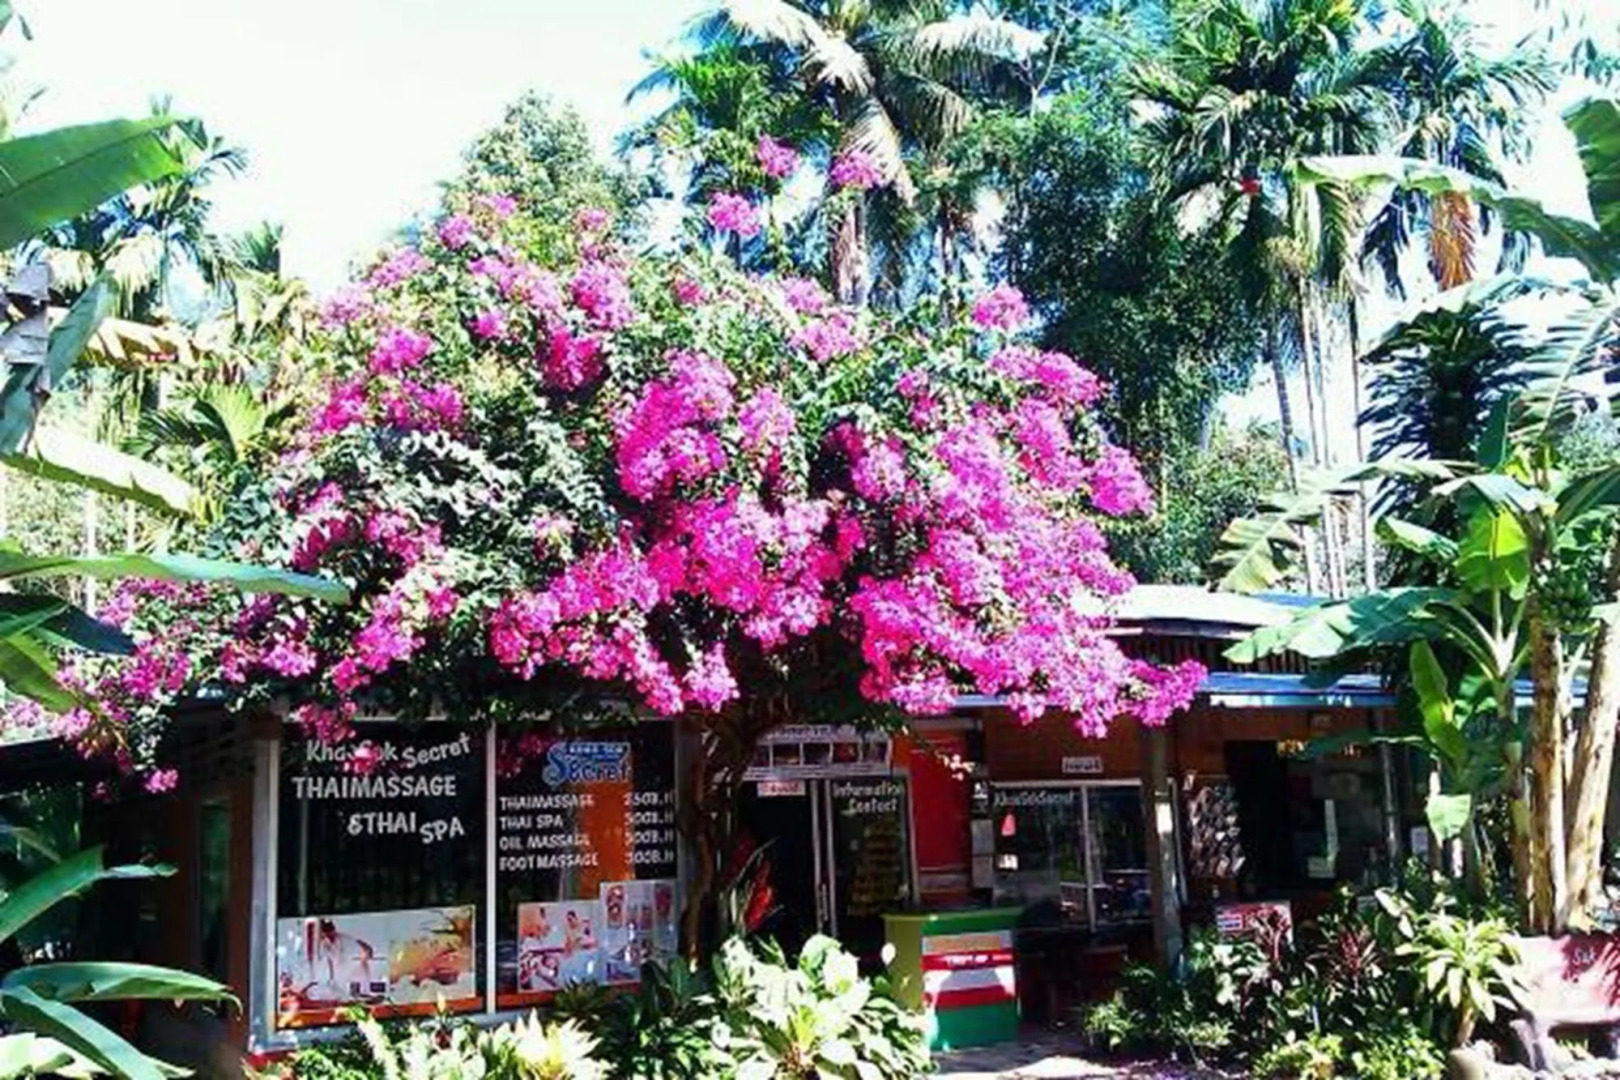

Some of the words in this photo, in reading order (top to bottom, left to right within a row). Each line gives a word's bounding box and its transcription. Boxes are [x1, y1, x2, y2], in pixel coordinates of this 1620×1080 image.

[402, 732, 470, 769] Secret
[292, 775, 457, 798] THAIMASSAGE
[419, 815, 466, 844] SPA
[499, 816, 533, 831] THAI
[535, 814, 564, 829] SPA
